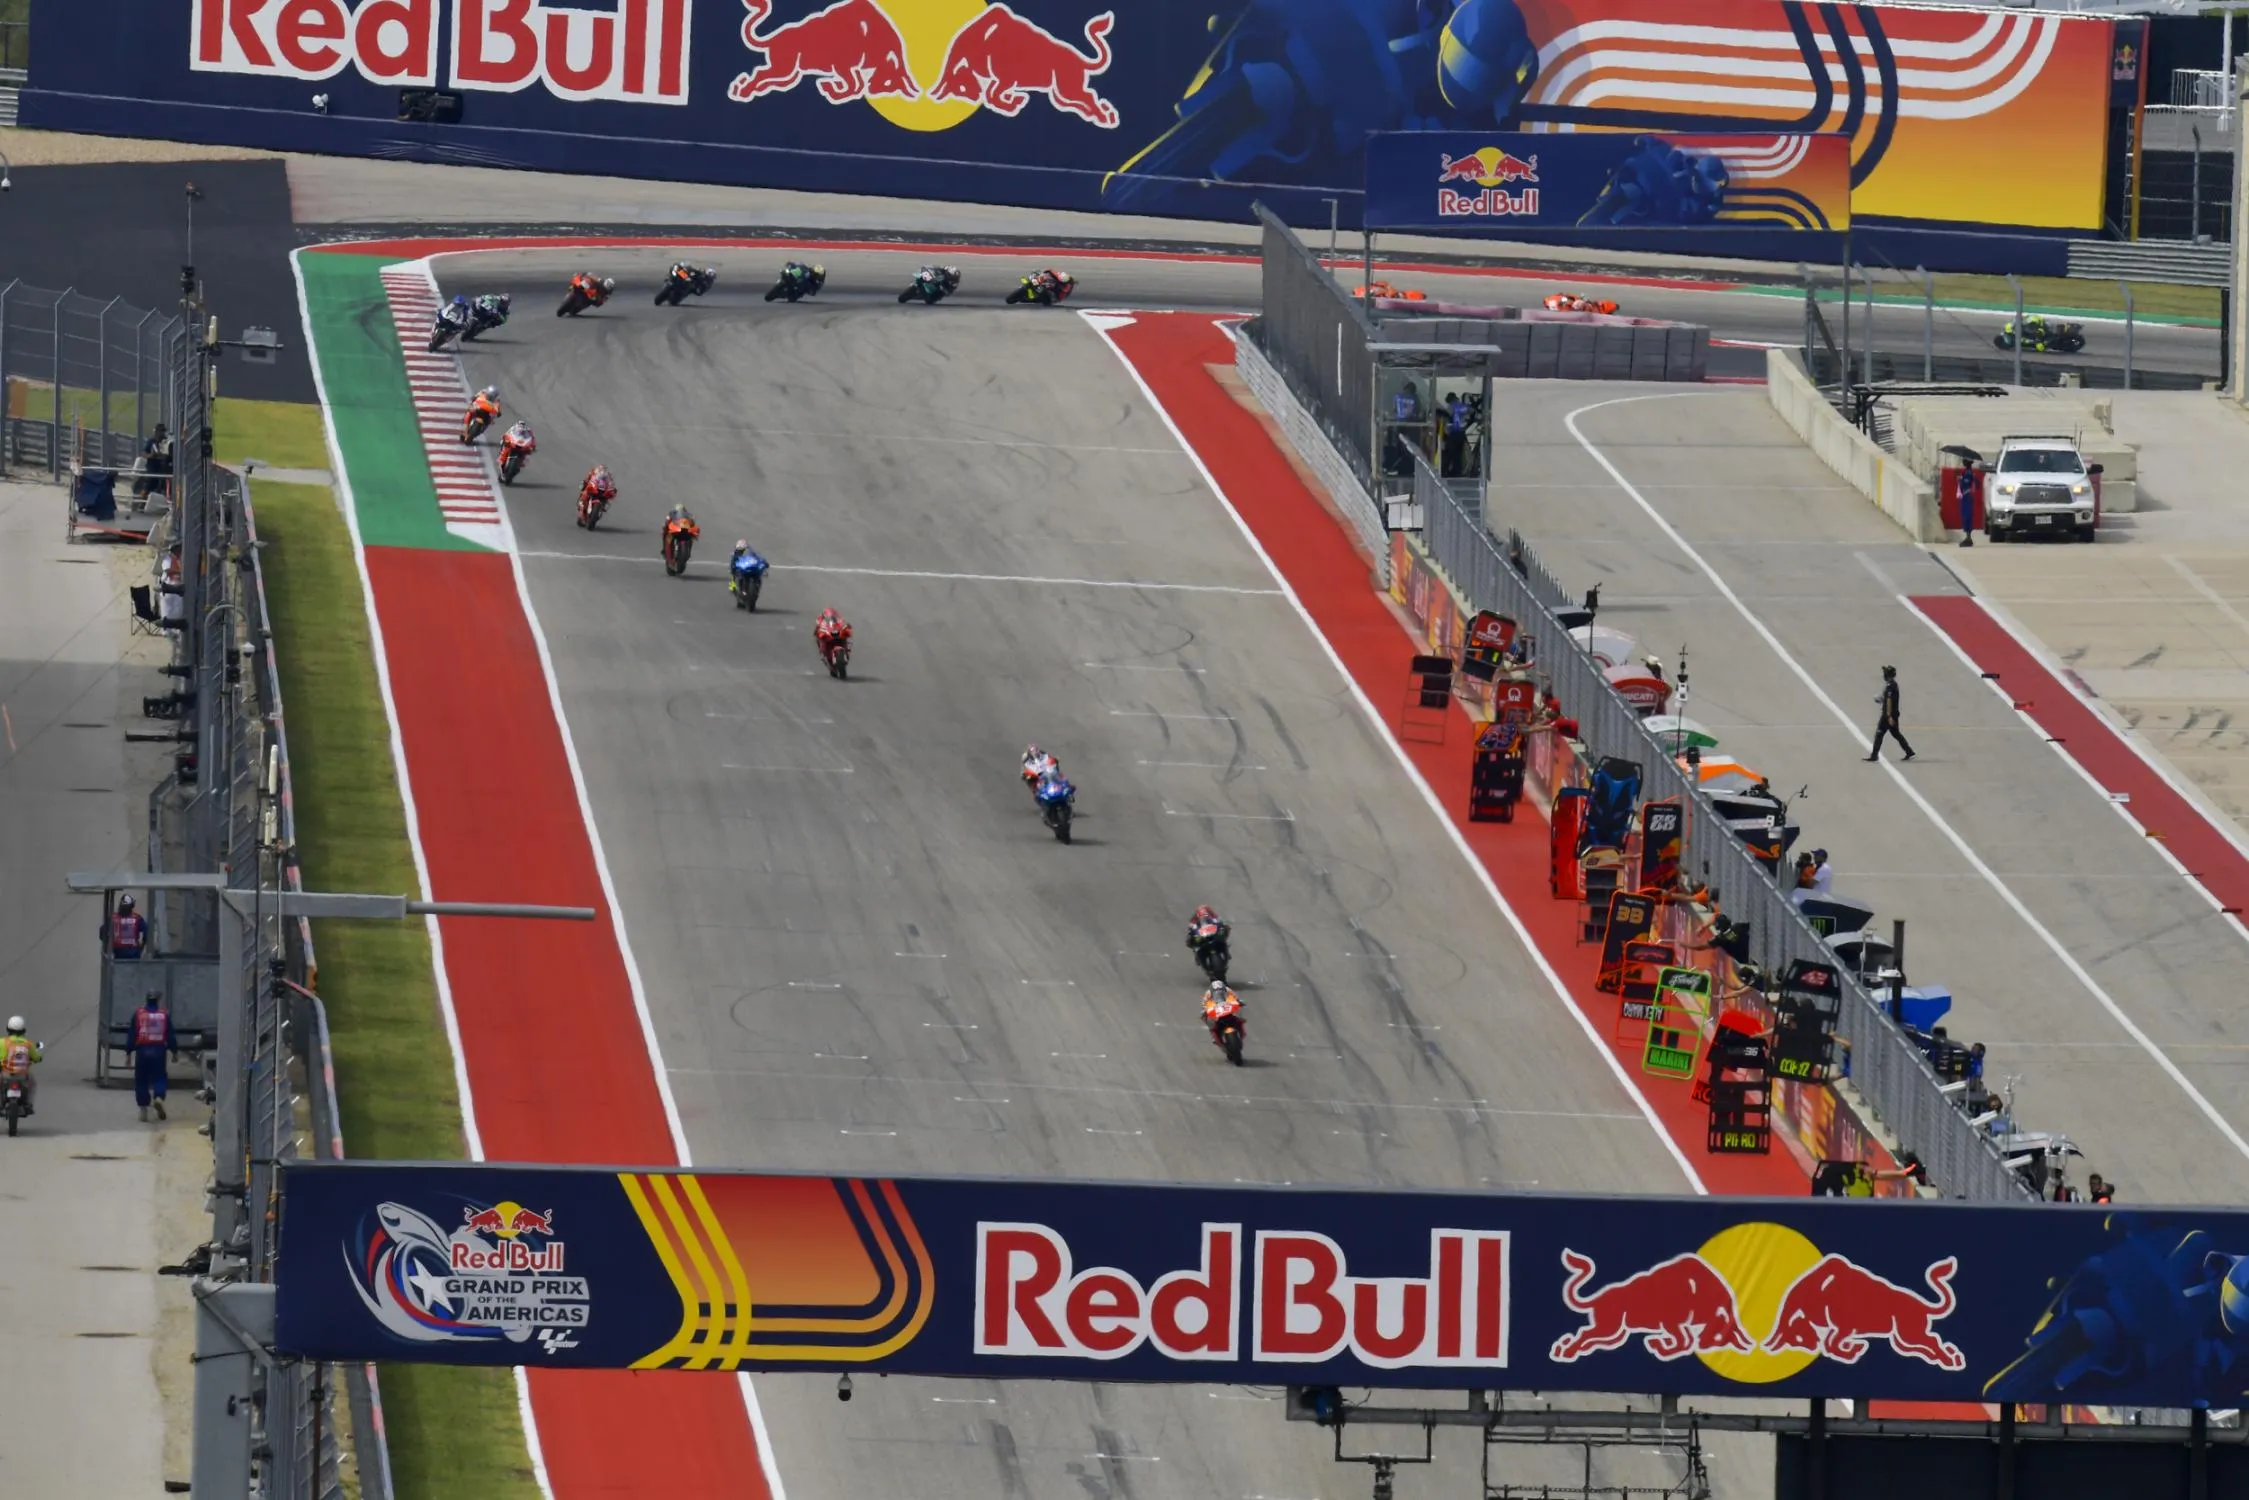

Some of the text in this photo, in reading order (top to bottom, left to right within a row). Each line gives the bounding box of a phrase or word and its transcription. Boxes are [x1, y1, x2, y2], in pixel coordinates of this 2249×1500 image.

[190, 0, 692, 105] Red Bull
[1439, 188, 1539, 216] Red Bull
[450, 1240, 565, 1272] Red Bull
[445, 1279, 584, 1296] GRAND PRIX
[477, 1296, 517, 1304] OF THE
[974, 1221, 1510, 1368] Red Bull
[466, 1306, 584, 1323] AMERICAS
